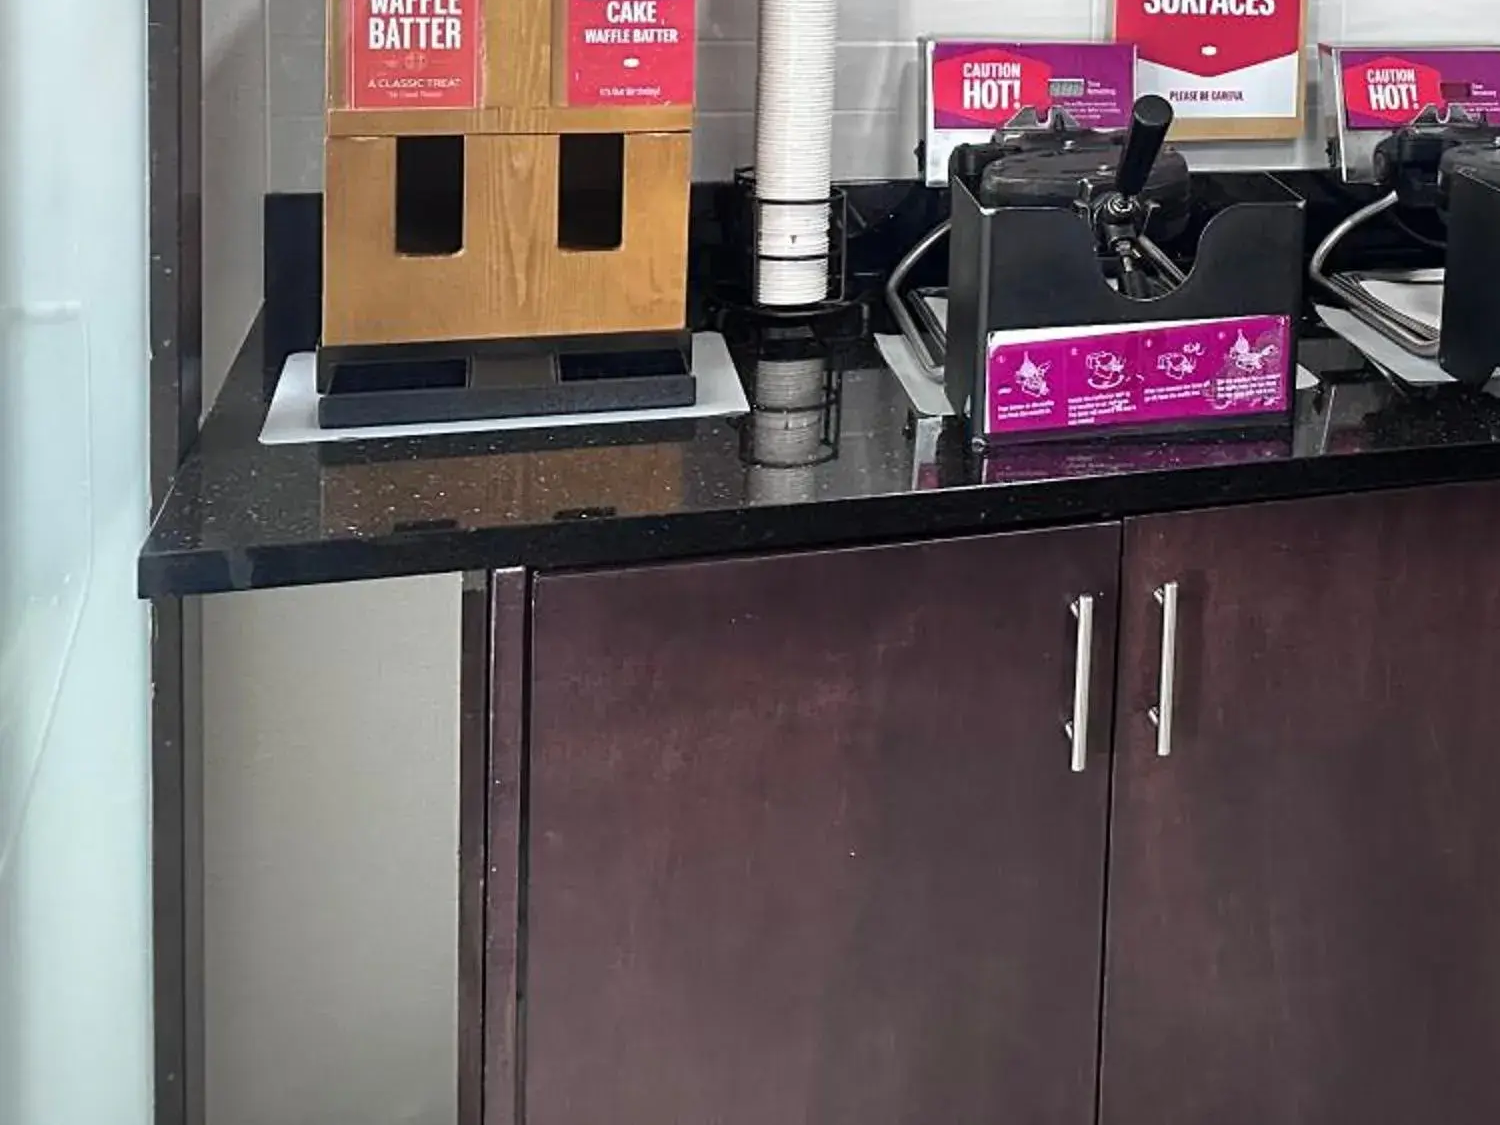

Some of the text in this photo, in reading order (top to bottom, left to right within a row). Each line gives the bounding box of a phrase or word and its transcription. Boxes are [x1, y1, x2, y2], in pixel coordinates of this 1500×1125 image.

[606, 0, 657, 24] CAKE
[368, 16, 462, 50] BATTER
[584, 28, 679, 44] WAFFLE BATTER
[962, 62, 1021, 78] CAUTION
[1367, 69, 1415, 83] CAUTION
[962, 80, 1022, 111] HOT!
[1169, 90, 1198, 101] PLEASE
[1368, 83, 1419, 110] HOT!
